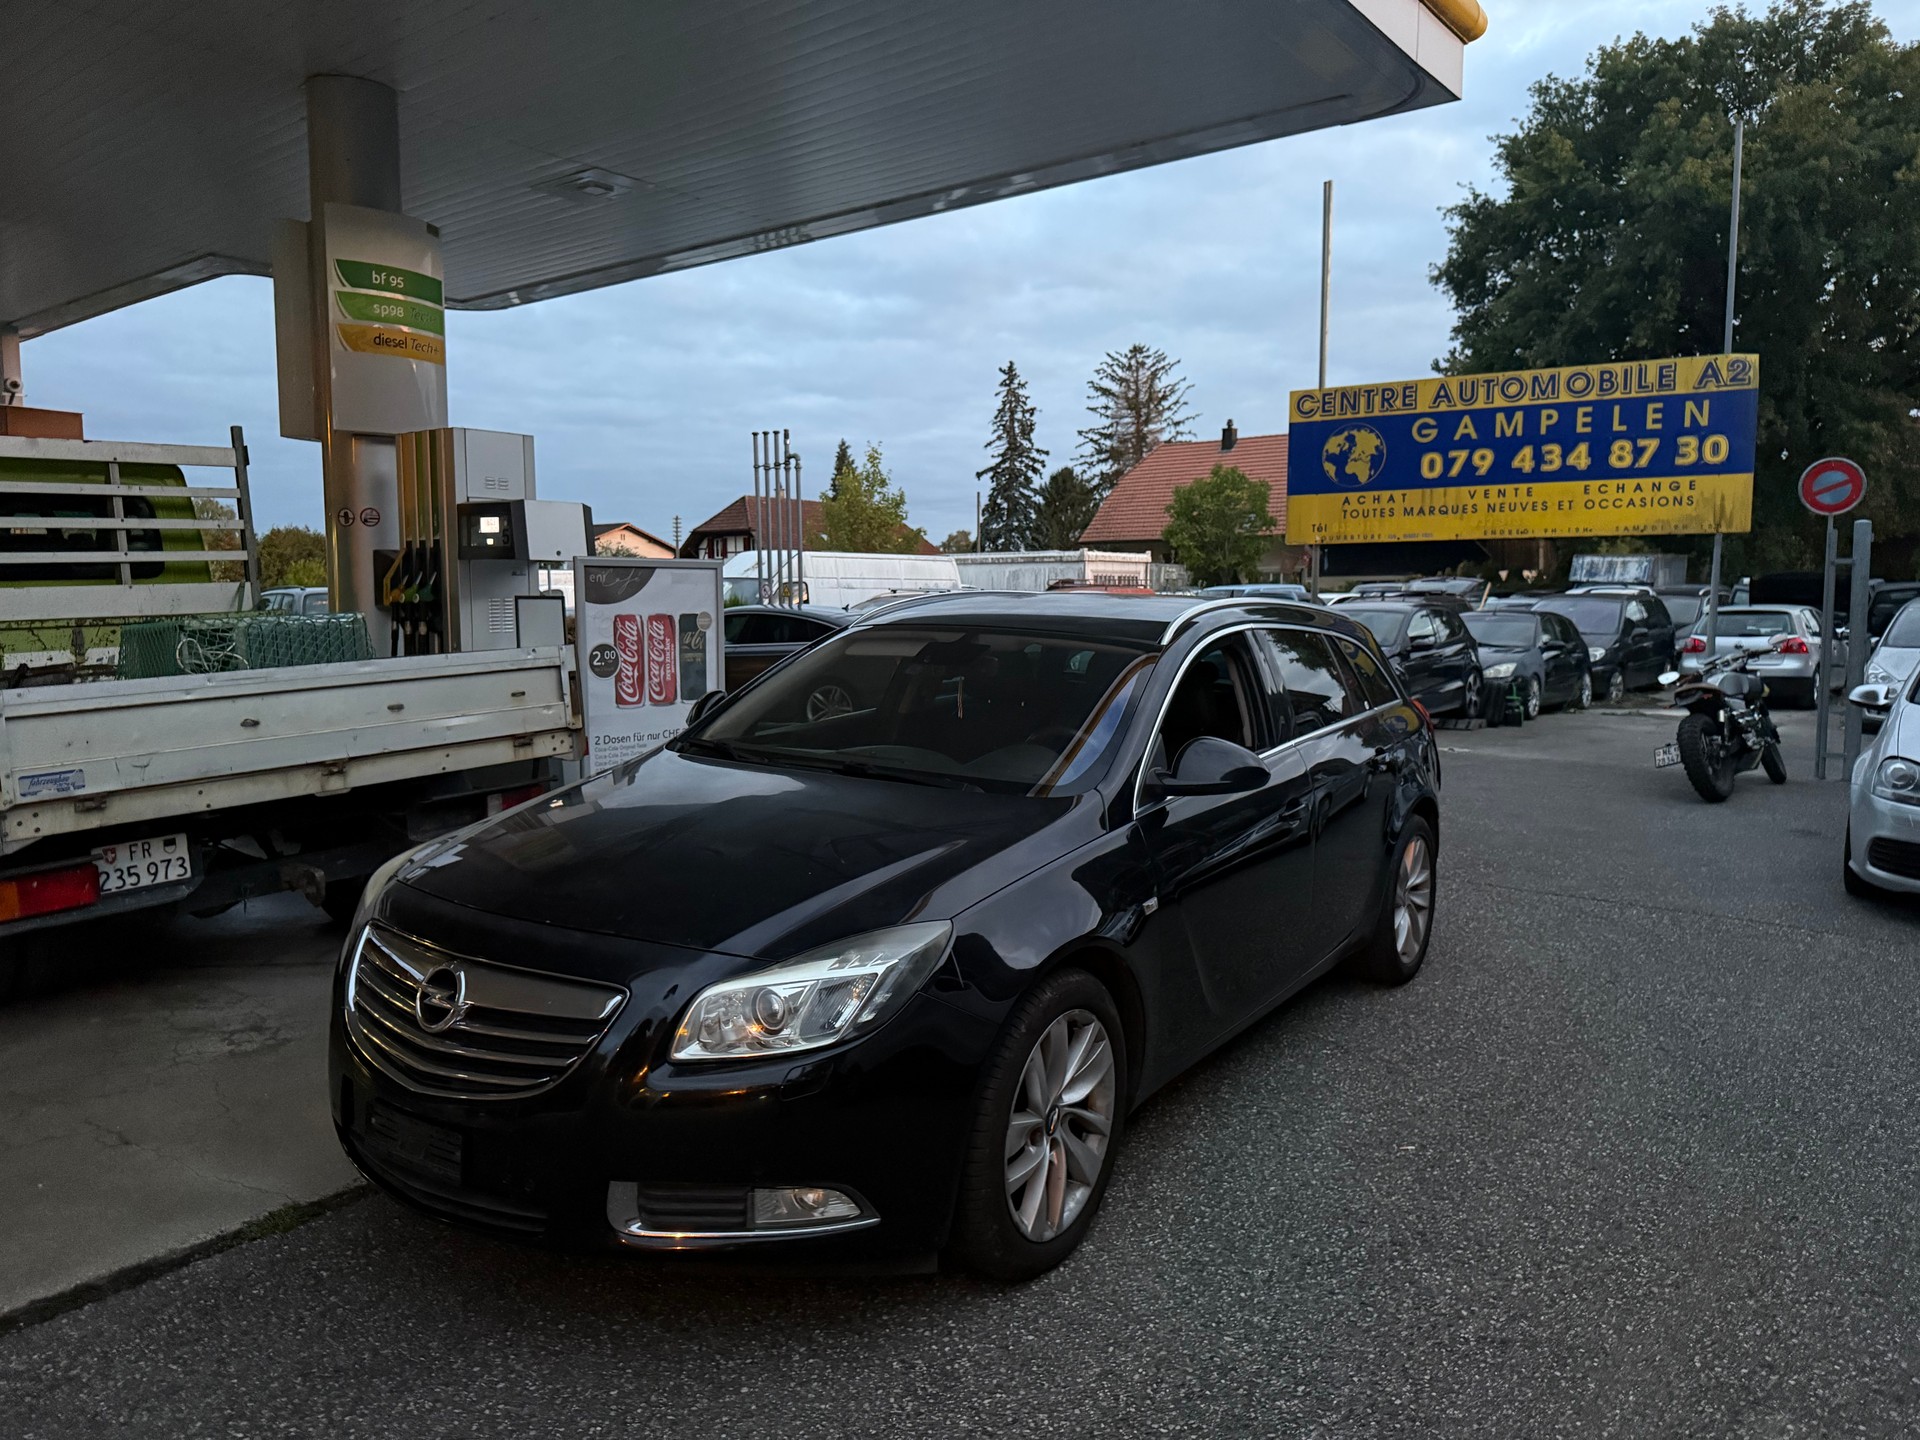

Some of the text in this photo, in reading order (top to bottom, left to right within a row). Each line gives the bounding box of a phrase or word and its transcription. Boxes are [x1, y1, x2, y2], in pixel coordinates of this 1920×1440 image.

[372, 271, 404, 288] bf 95
[373, 304, 404, 317] sp98
[373, 333, 439, 354] diesel Tech+
[1296, 357, 1751, 418] CENTRE AUTOMOBILE A2
[1412, 399, 1710, 443] GAMPELEN
[1420, 434, 1729, 479] 079 434 87 30
[1342, 480, 1696, 506] ACHAT VENTE ECHANGE
[1342, 495, 1694, 519] TOUTES MARQUES NEUVES ET OCCASIONS
[595, 736, 601, 745] 2
[603, 734, 632, 745] Dosen
[633, 732, 645, 742] für
[647, 733, 660, 741] nur
[662, 728, 681, 739] CHF
[129, 842, 152, 861] FR
